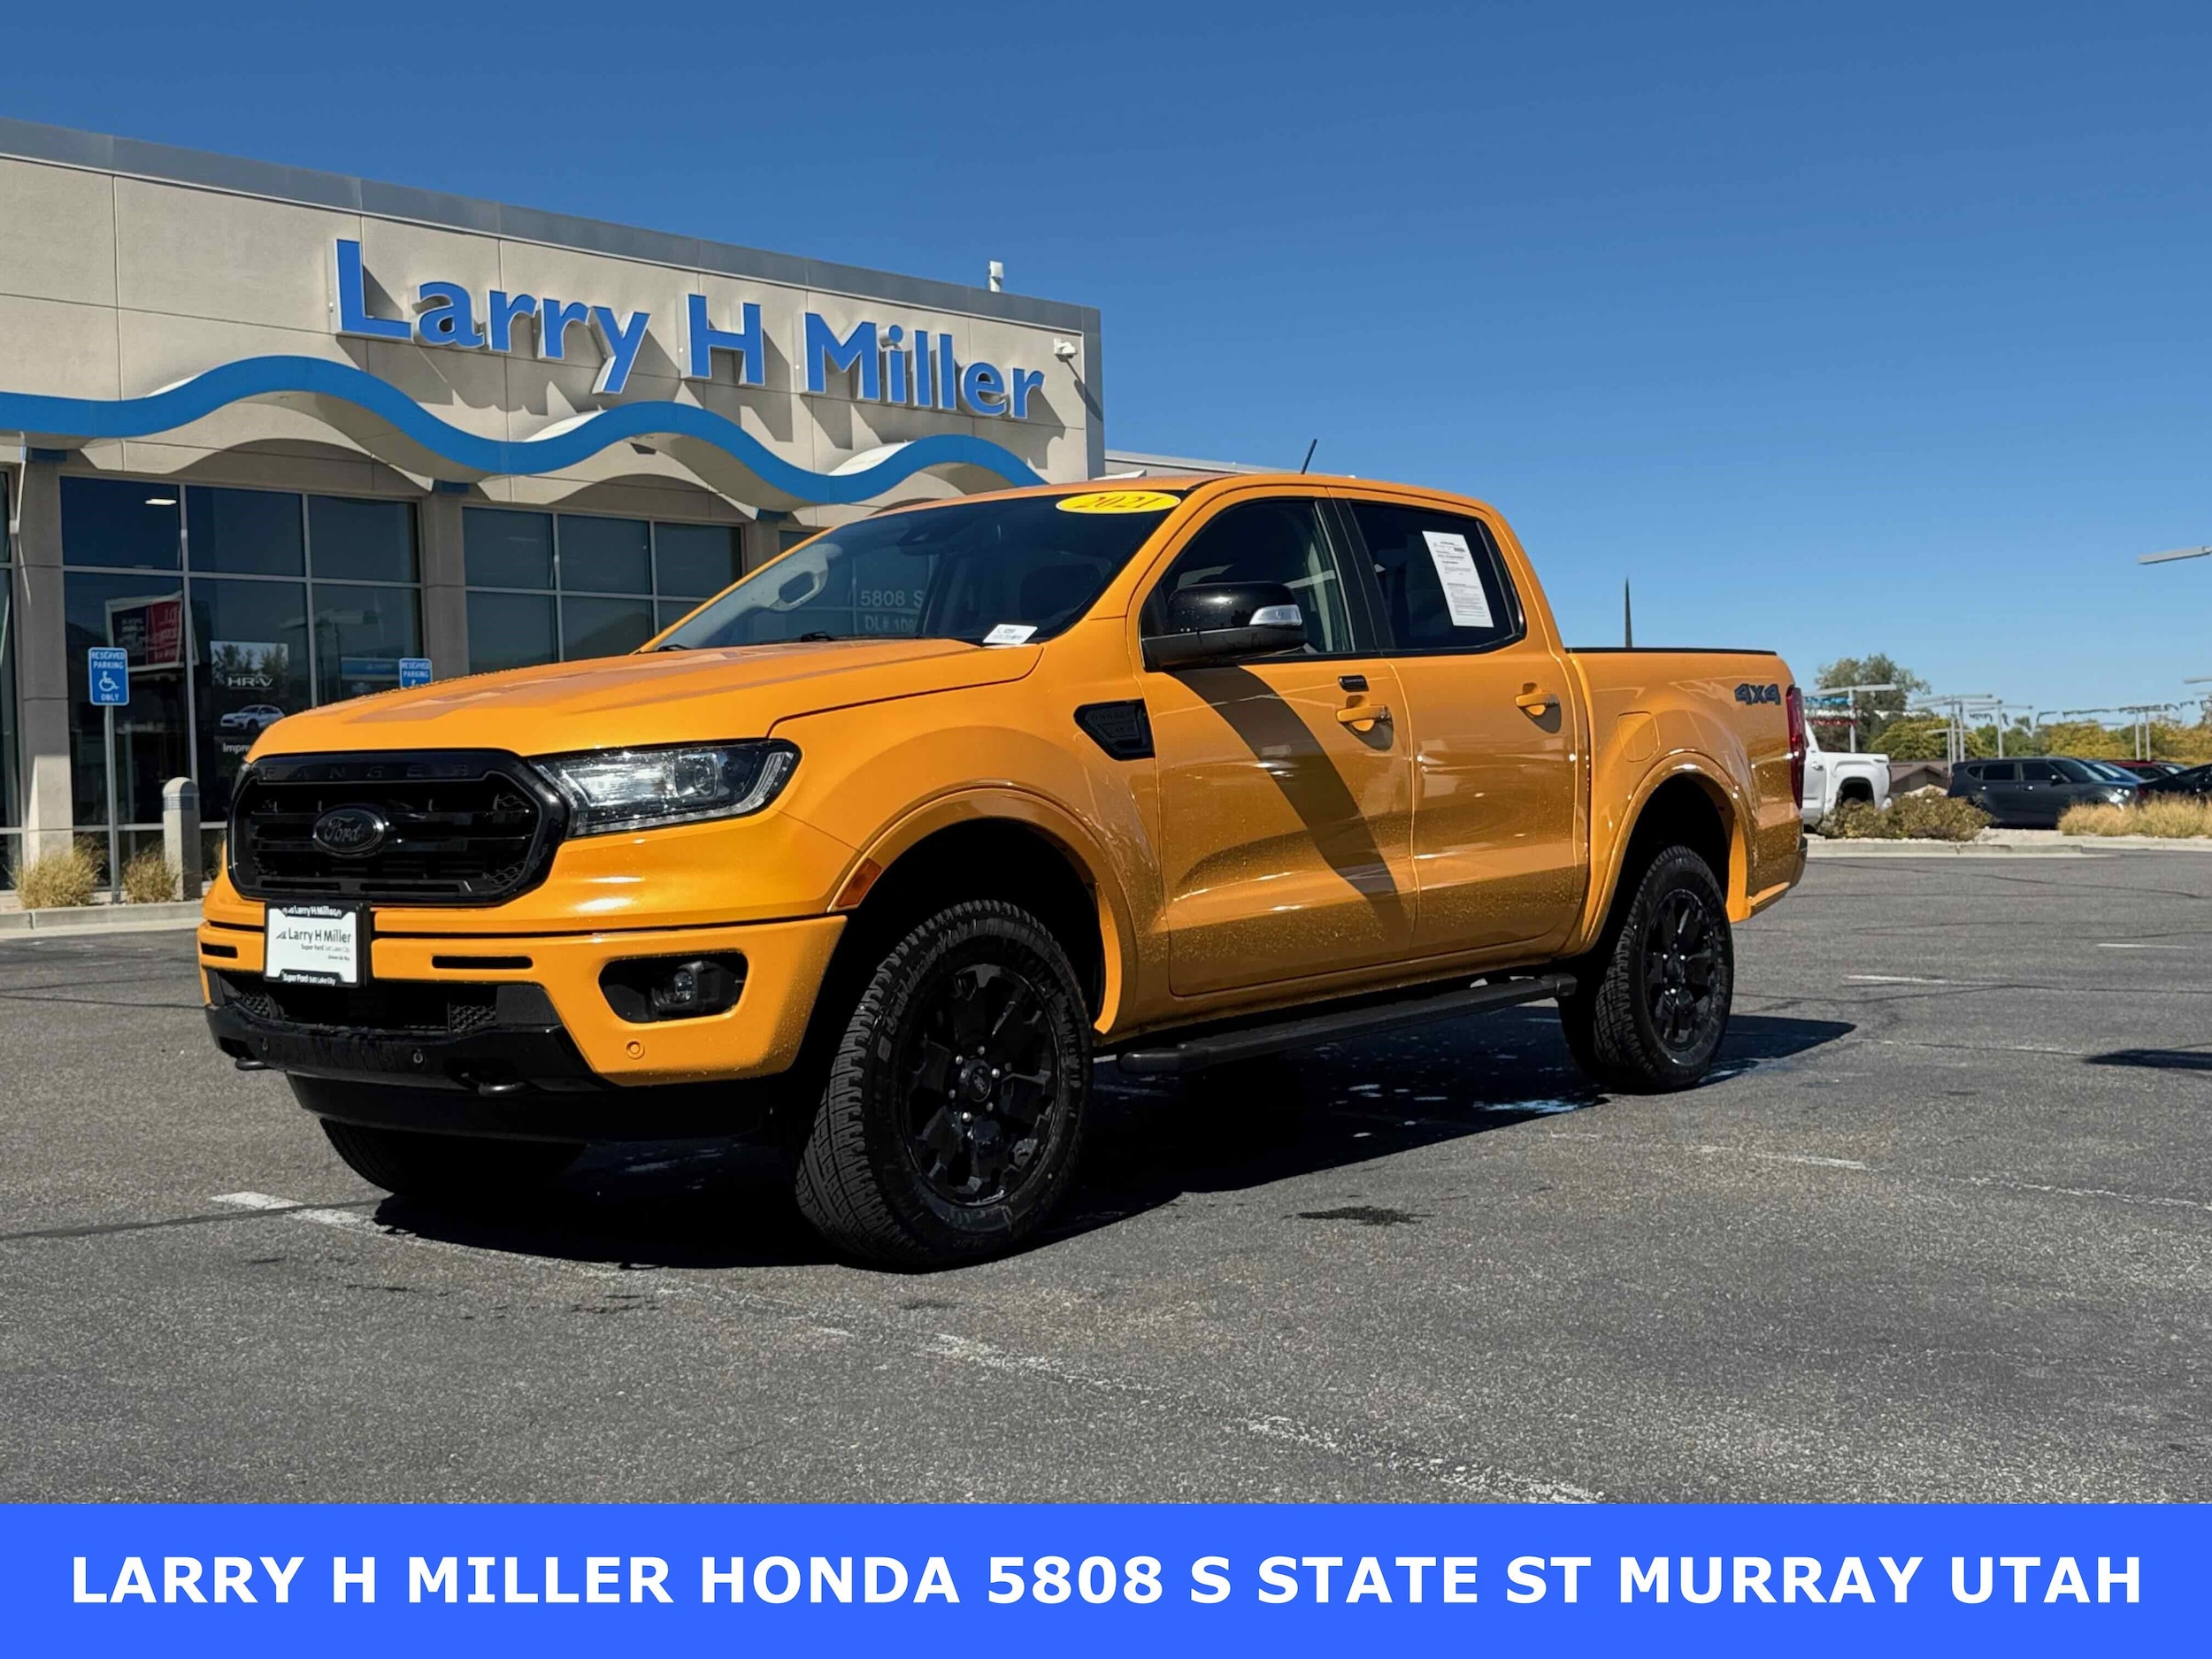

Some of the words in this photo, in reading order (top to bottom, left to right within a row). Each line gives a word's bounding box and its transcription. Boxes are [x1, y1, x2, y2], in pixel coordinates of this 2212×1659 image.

[329, 238, 650, 395] Larry
[682, 294, 765, 386] H
[802, 311, 1046, 419] Miller
[1071, 495, 1162, 509] 2021
[861, 589, 906, 607] 5808
[913, 589, 925, 608] S
[90, 651, 126, 660] RESERVED
[227, 676, 273, 687] HR-V
[100, 693, 119, 702] ONLY
[324, 817, 363, 841] Ford
[288, 927, 313, 944] Larry
[315, 929, 322, 941] H
[324, 929, 351, 943] Miller
